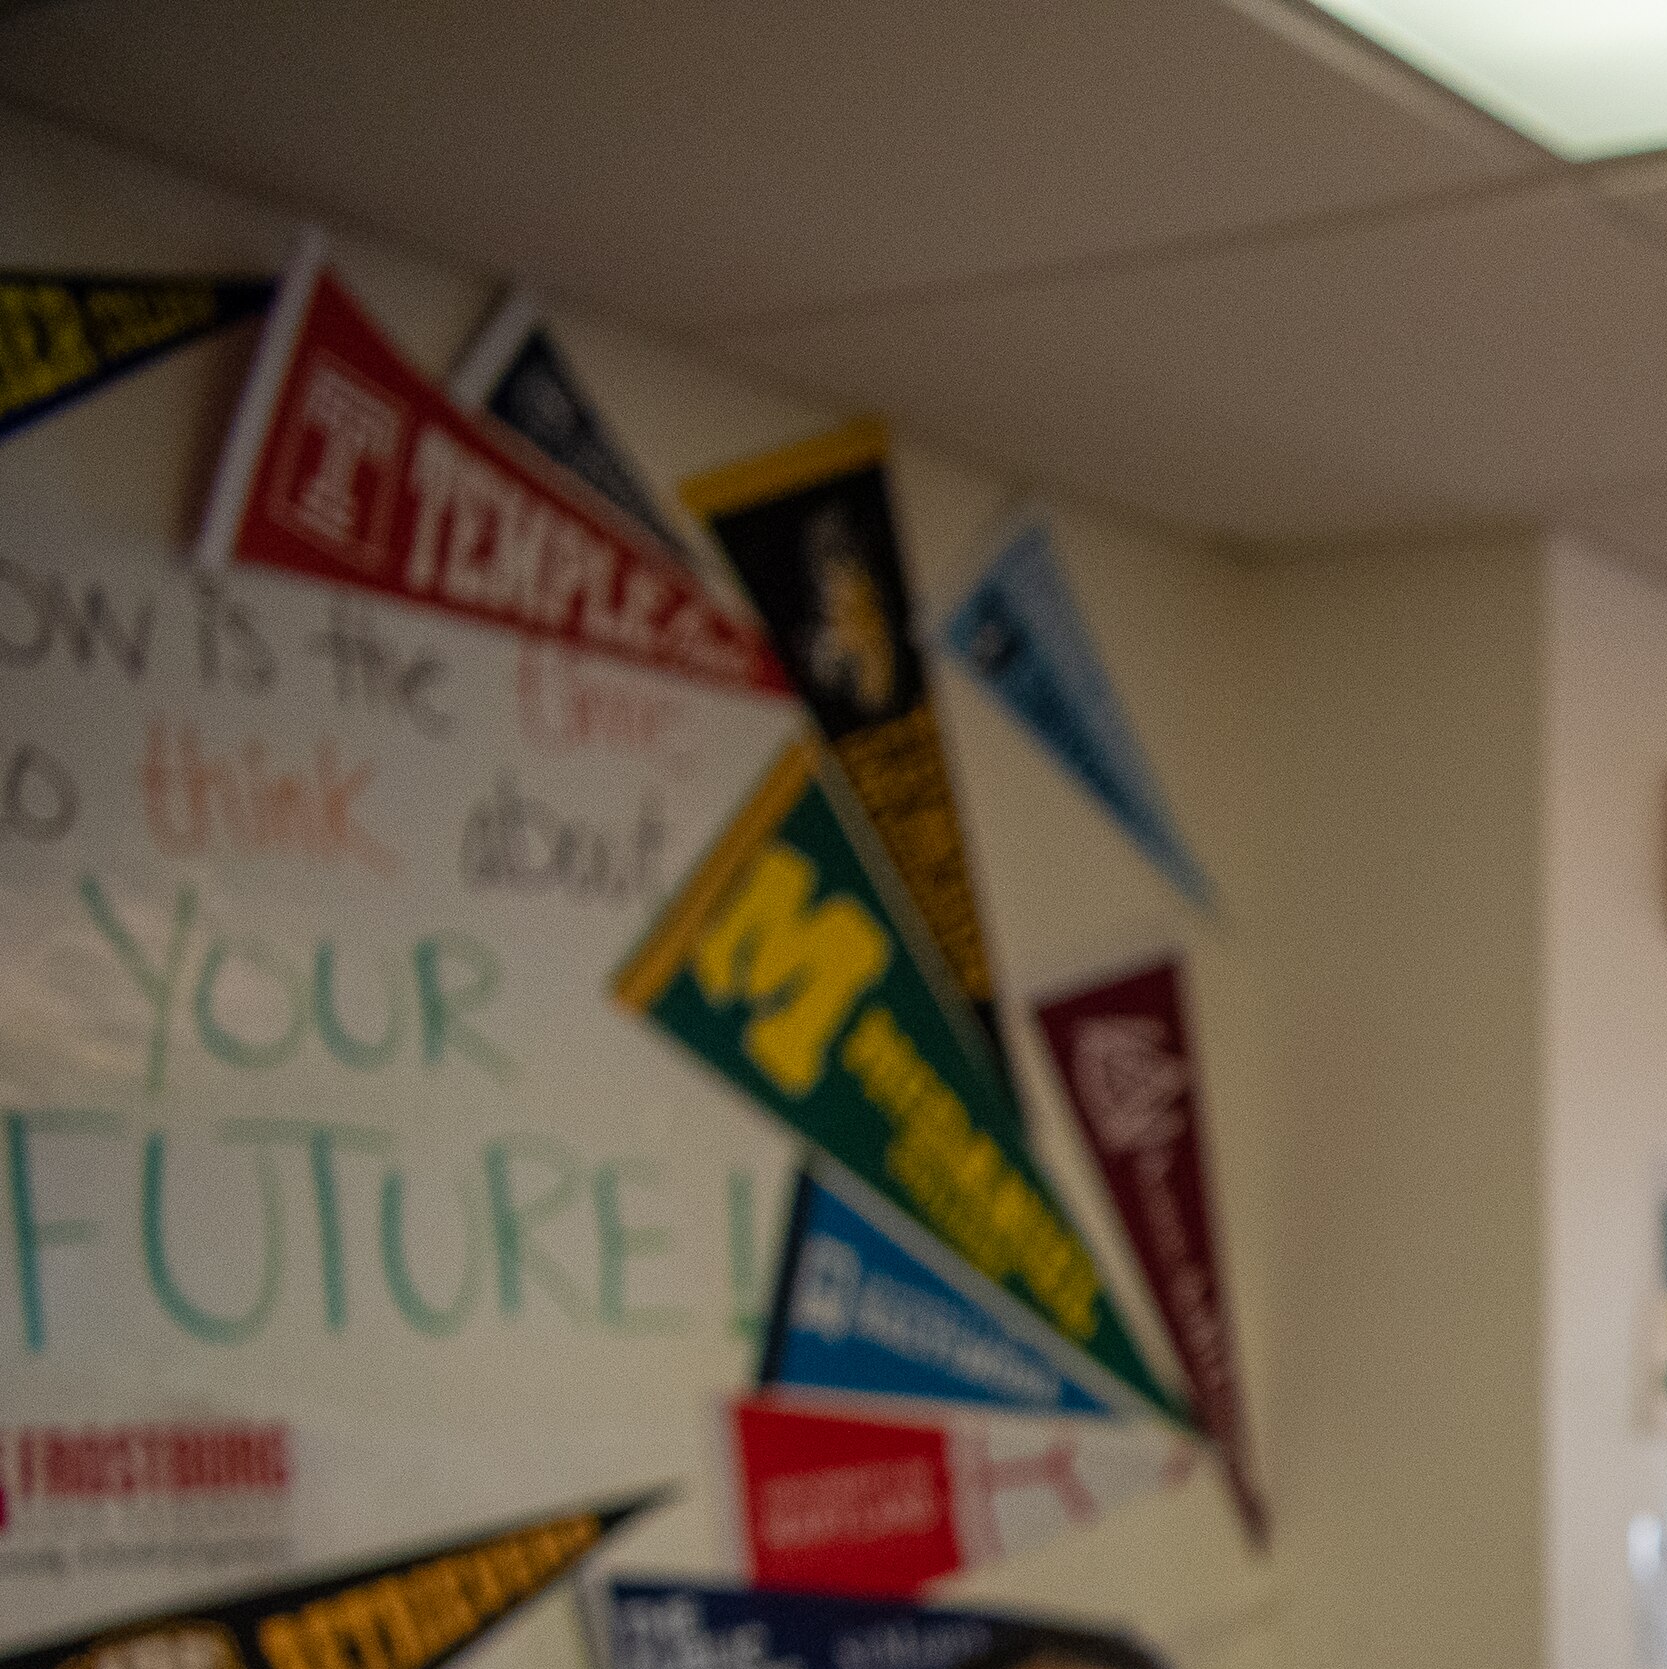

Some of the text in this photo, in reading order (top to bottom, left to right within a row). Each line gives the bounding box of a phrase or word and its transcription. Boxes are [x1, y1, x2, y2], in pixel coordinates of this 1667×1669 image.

[406, 427, 702, 660] TEMPLE
[300, 597, 453, 742] the
[140, 709, 400, 878] think
[78, 876, 520, 1102] YOUR
[3, 1106, 766, 1352] FUTURE!
